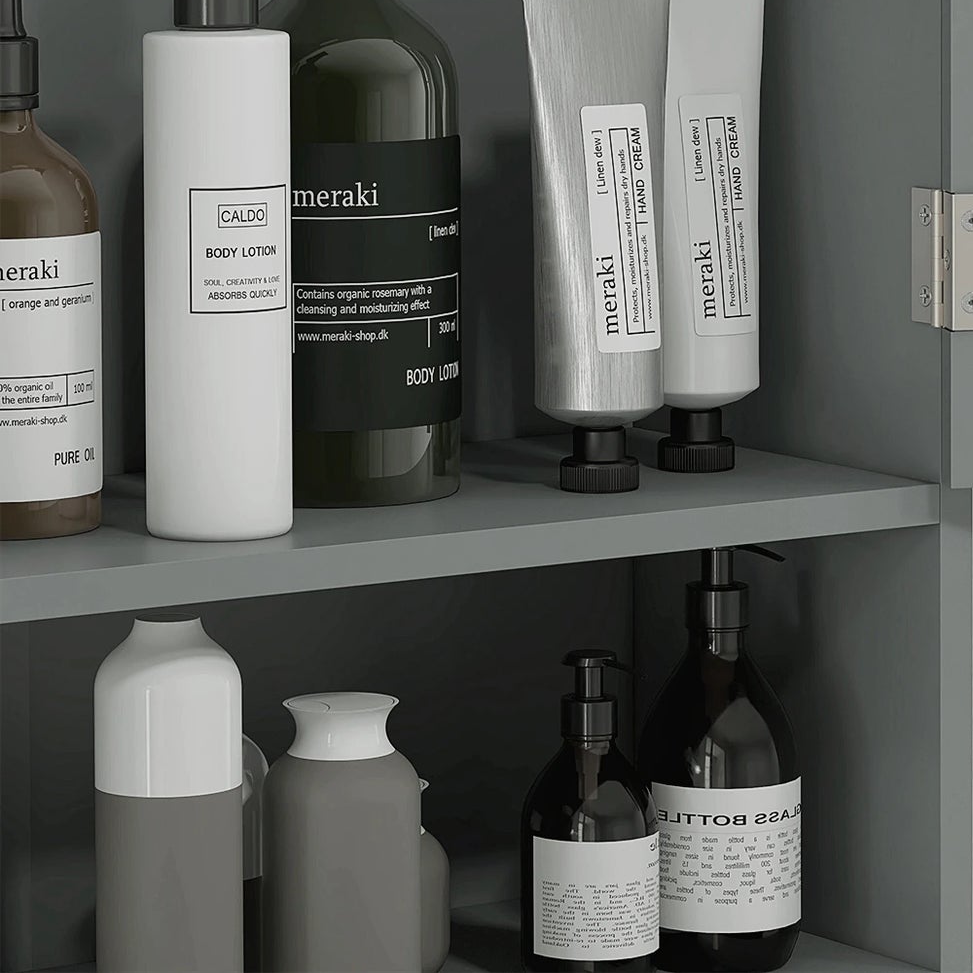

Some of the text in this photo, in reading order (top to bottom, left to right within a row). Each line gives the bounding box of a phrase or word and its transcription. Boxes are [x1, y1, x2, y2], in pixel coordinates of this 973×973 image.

[691, 126, 703, 174] Linen dew
[727, 116, 743, 200] HAND CREAM
[593, 138, 606, 187] Linen dew
[631, 127, 647, 214] HAND CREAM
[292, 182, 379, 207] meraki
[221, 209, 264, 222] CALDO
[714, 138, 736, 306] Protects, moisturizes and repairs dry hands
[617, 149, 640, 323] Protects, moisturizes and repairs dry hands
[206, 245, 276, 258] BODY LOTION
[0, 260, 59, 281] eraki
[737, 220, 749, 304] www.meraki-shop.dk
[226, 277, 263, 285] CREATIVITY
[641, 235, 652, 320] www.meraki-shop.dk
[694, 240, 716, 318] meraki
[208, 289, 277, 300] ABSORBS QUICKLY
[296, 284, 432, 301] Contains organic rosemary with a
[596, 255, 619, 335] meraki
[9, 294, 91, 311] orange and geranium
[296, 300, 430, 316] cleansing and moisturizing effect
[297, 329, 389, 343] www.meraki-shop.dk
[439, 321, 450, 334] 300
[406, 367, 435, 386] BODY
[14, 382, 43, 394] organic
[45, 381, 54, 391] oil
[74, 383, 84, 394] 100
[1, 393, 63, 404] the entire family
[0, 414, 67, 427] w.meraki-shop.dk
[54, 447, 95, 466] PURE OIL
